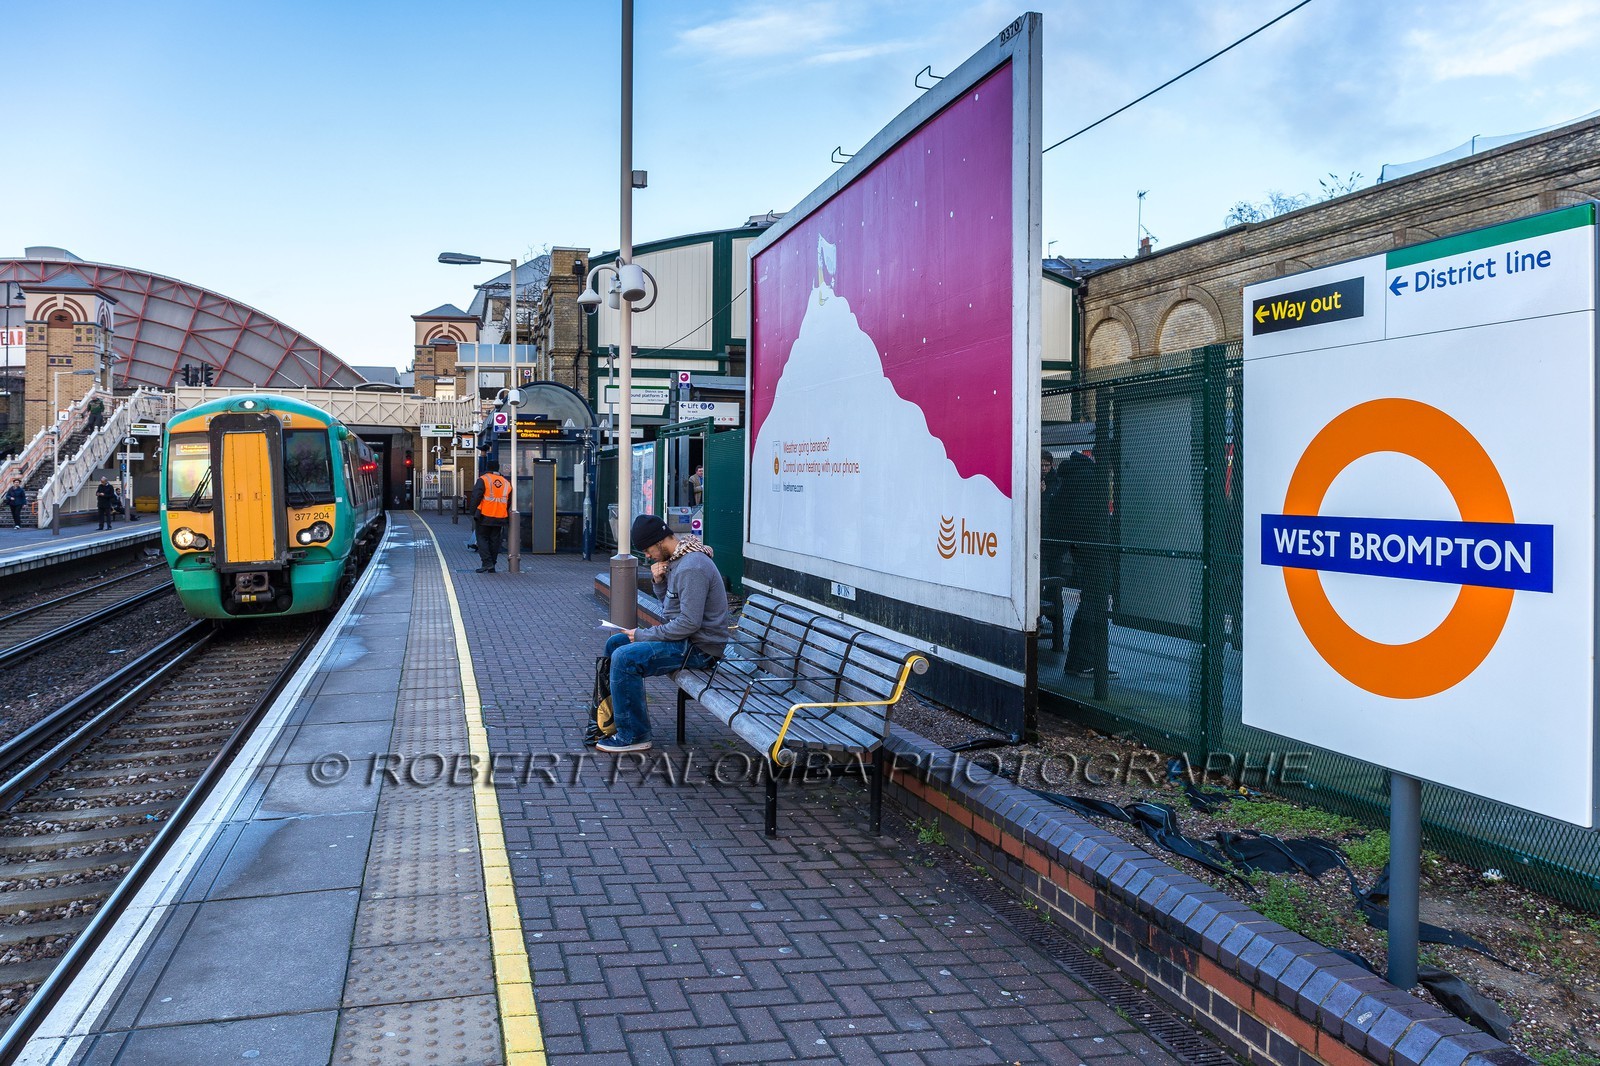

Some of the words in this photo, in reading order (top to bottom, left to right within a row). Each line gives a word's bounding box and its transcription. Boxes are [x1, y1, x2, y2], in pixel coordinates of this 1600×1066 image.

[1000, 21, 1020, 43] 0370
[1415, 258, 1497, 293] District
[1506, 250, 1552, 275] line
[1271, 300, 1307, 321] Way
[1310, 291, 1342, 313] out
[783, 440, 798, 453] Weather
[799, 441, 809, 456] going
[810, 437, 830, 452] bananas?
[783, 459, 797, 473] Control
[797, 463, 805, 476] your
[806, 458, 820, 476] heating
[822, 458, 831, 473] with
[831, 463, 842, 477] your
[842, 458, 860, 477] phone.
[294, 512, 311, 521] 377
[313, 511, 330, 520] 204
[961, 517, 998, 558] hive
[1273, 527, 1341, 558] WEST
[1350, 532, 1532, 574] BROMPTON
